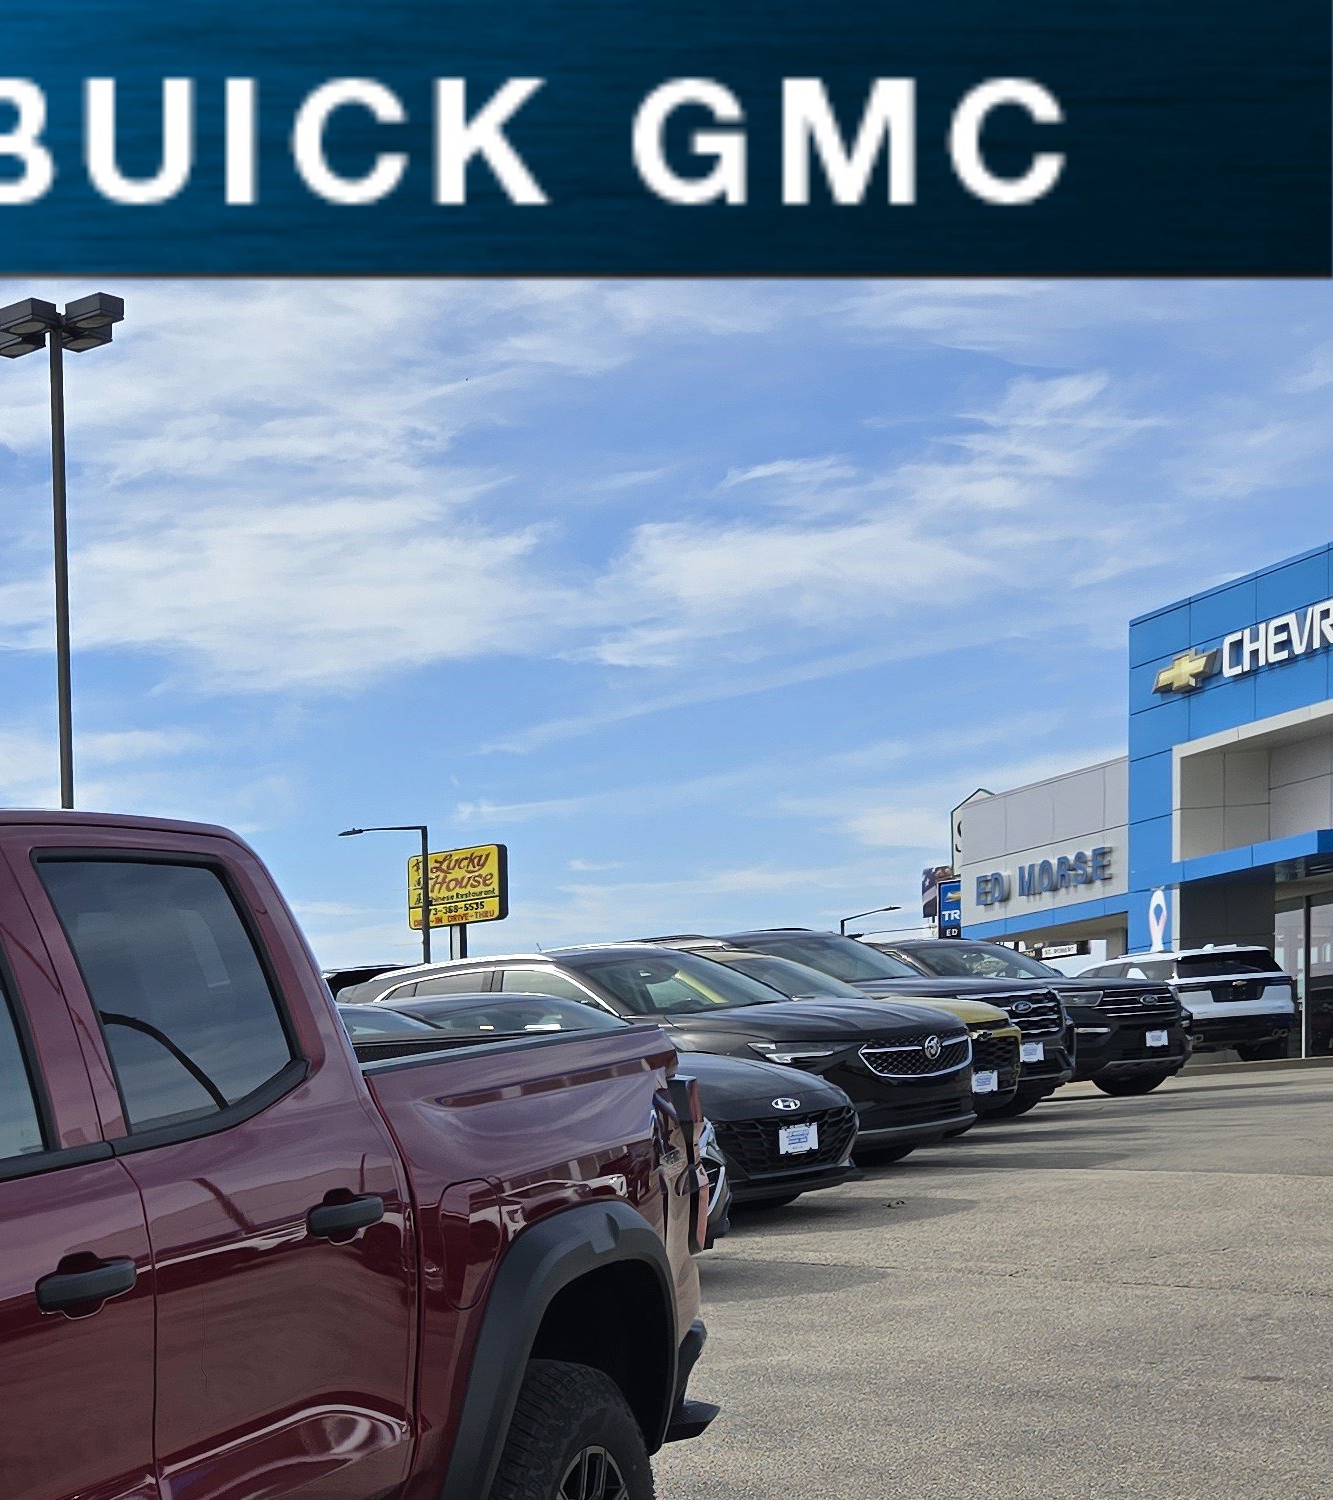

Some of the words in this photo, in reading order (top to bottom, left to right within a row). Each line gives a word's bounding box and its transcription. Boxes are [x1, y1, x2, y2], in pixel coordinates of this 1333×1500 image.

[1222, 599, 1333, 679] CHEVR
[429, 871, 494, 894] House
[430, 851, 491, 875] Lucky
[975, 871, 1006, 907] ED
[1017, 846, 1113, 898] MORSE
